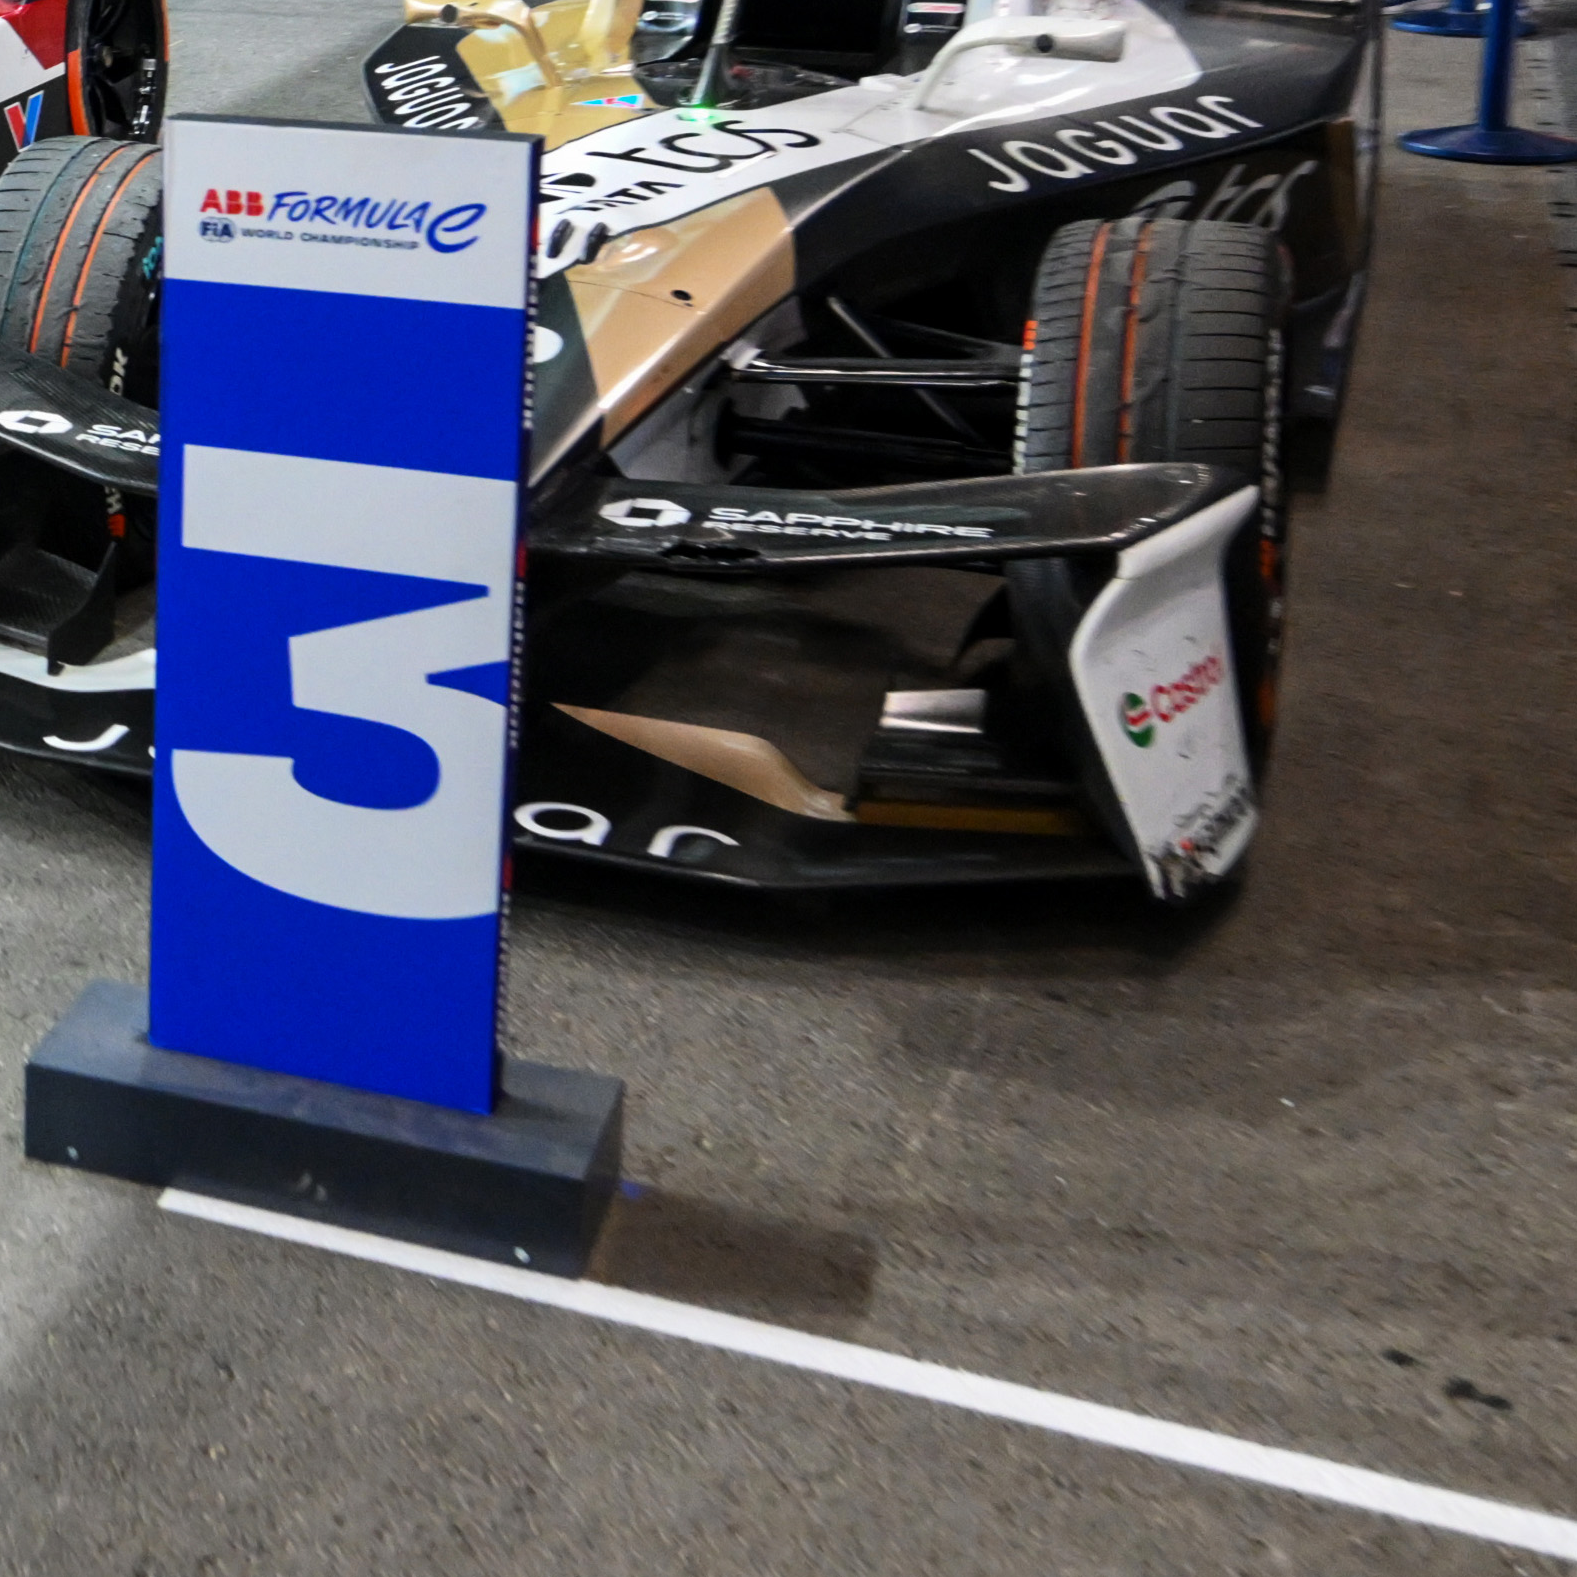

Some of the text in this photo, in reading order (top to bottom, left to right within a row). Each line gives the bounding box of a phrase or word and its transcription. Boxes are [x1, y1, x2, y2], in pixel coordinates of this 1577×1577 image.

[199, 188, 264, 217] ABB
[266, 190, 432, 234] FORMULA
[199, 219, 420, 251] FIA WORLD CHAMPIONSHIP
[701, 520, 893, 541] RESERVE
[708, 507, 995, 539] SAPPHIRE
[171, 443, 518, 921] 3
